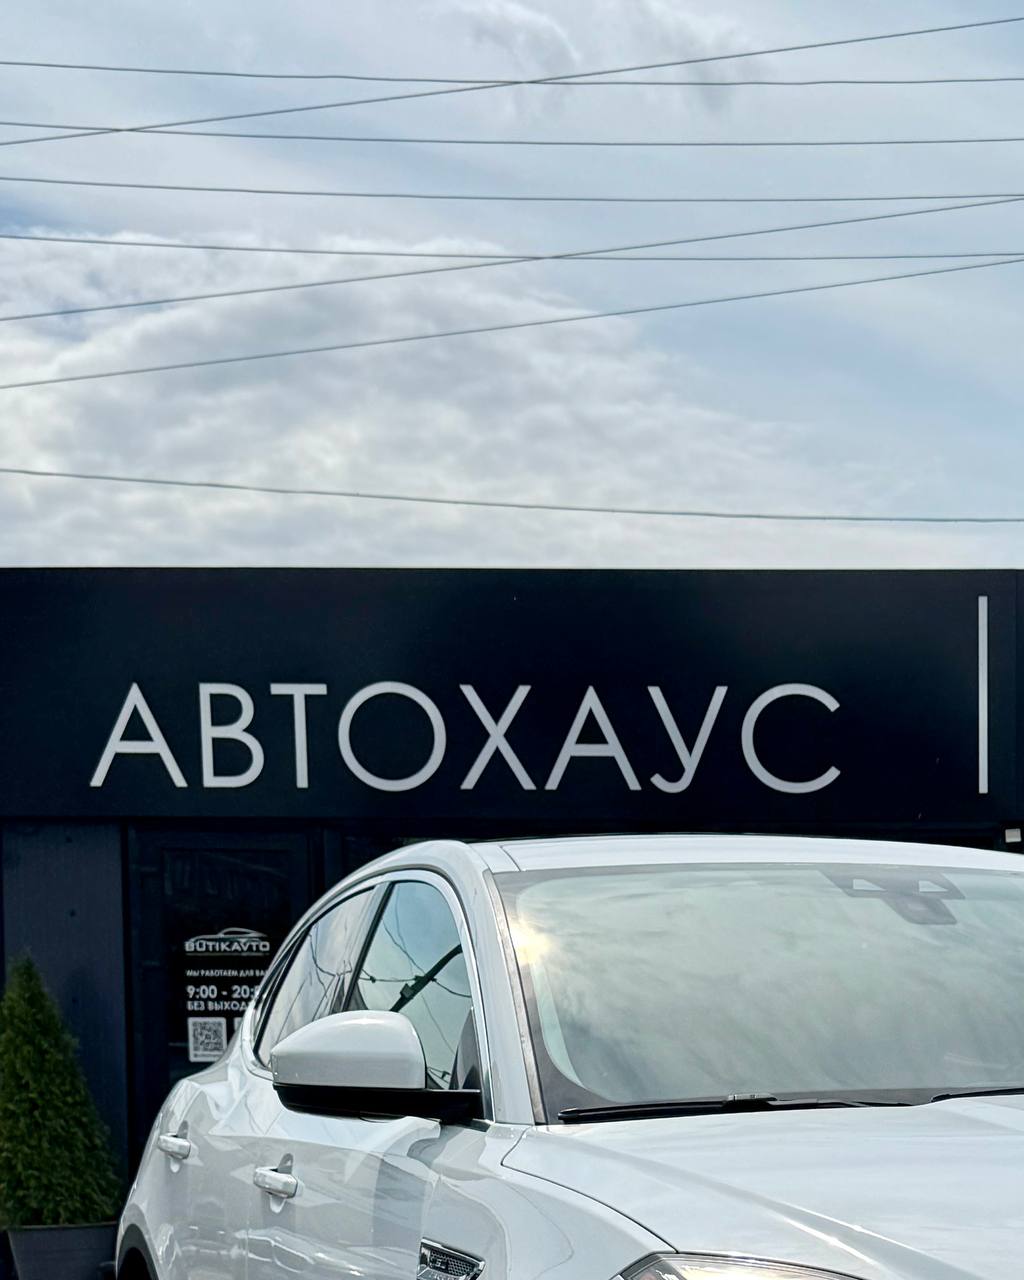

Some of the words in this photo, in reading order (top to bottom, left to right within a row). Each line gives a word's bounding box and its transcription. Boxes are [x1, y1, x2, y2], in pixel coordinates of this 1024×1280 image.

[90, 682, 840, 793] АВТОХАУС
[184, 941, 271, 952] BUTIKAVTO
[201, 969, 239, 977] РАБОТАЕМ
[255, 969, 267, 977] ВА
[186, 985, 218, 998] 9:00
[187, 1001, 205, 1011] БЕЗ
[207, 1001, 250, 1011] ВЫХОД
